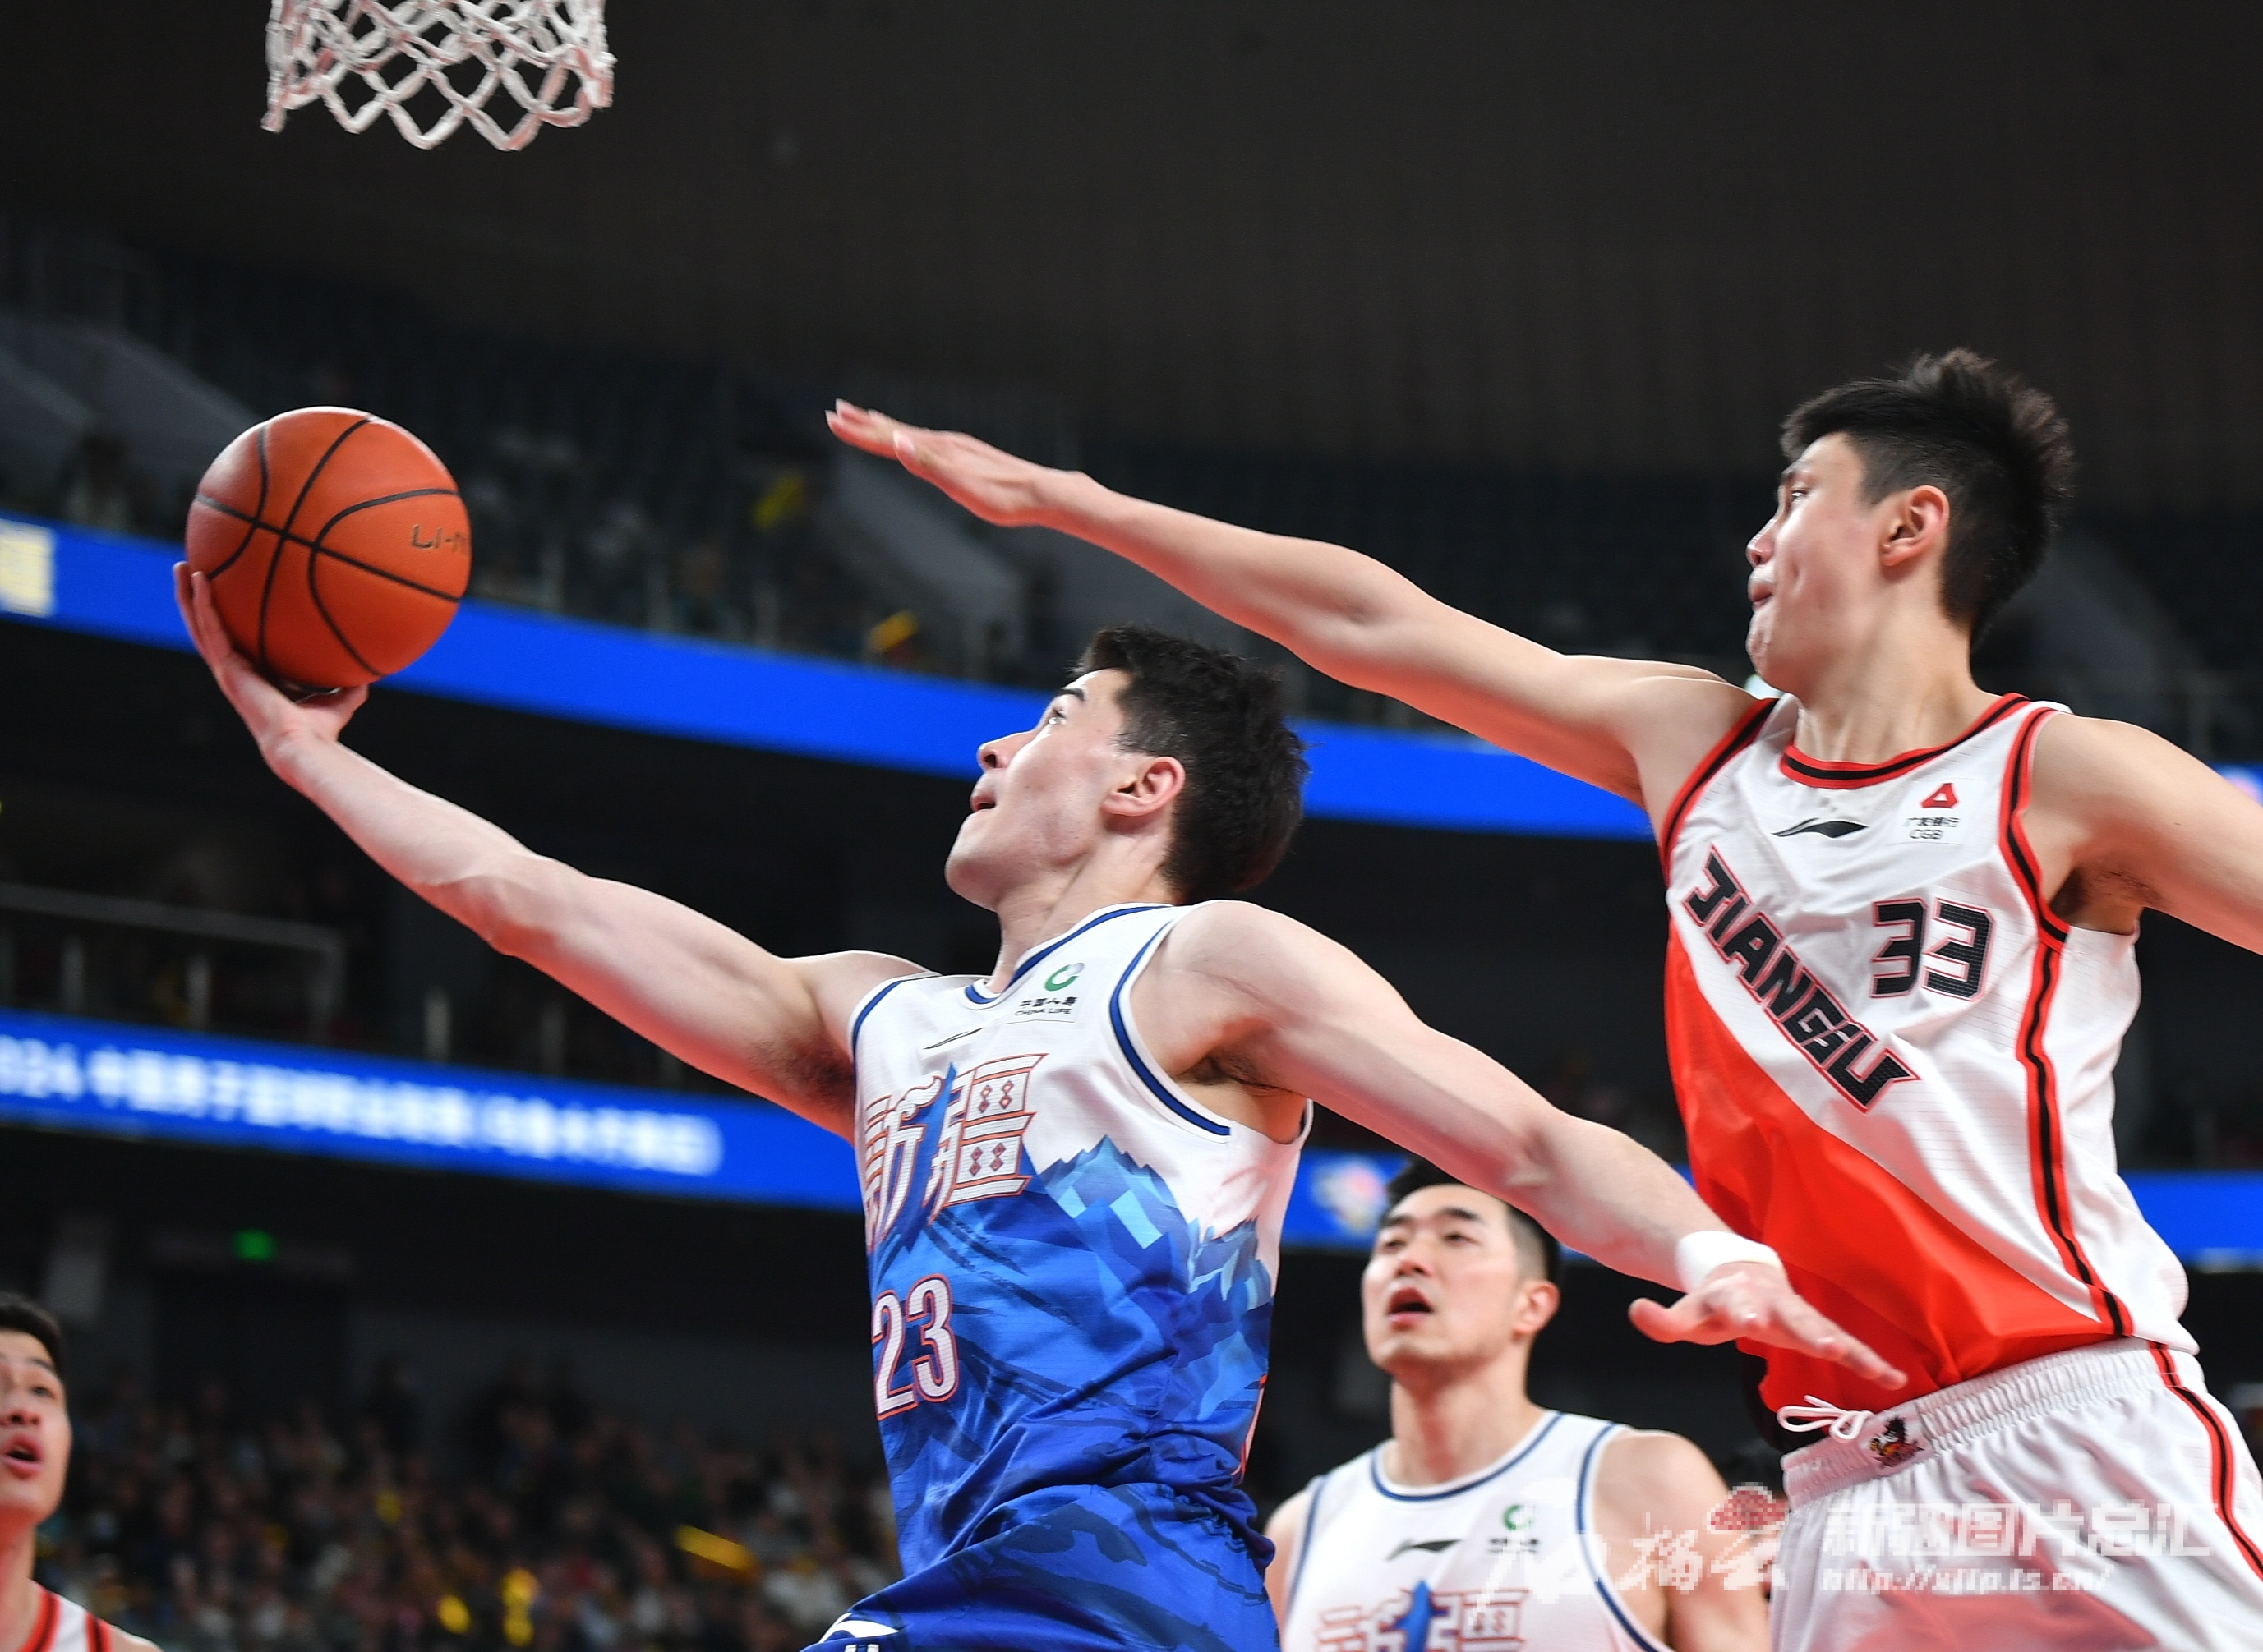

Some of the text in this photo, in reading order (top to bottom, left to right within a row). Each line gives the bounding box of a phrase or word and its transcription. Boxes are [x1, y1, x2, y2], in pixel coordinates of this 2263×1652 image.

[1909, 829, 1943, 840] CGB
[1682, 844, 1921, 1114] JIANGSU
[1871, 897, 1995, 1002] 33
[871, 1272, 960, 1421] 23
